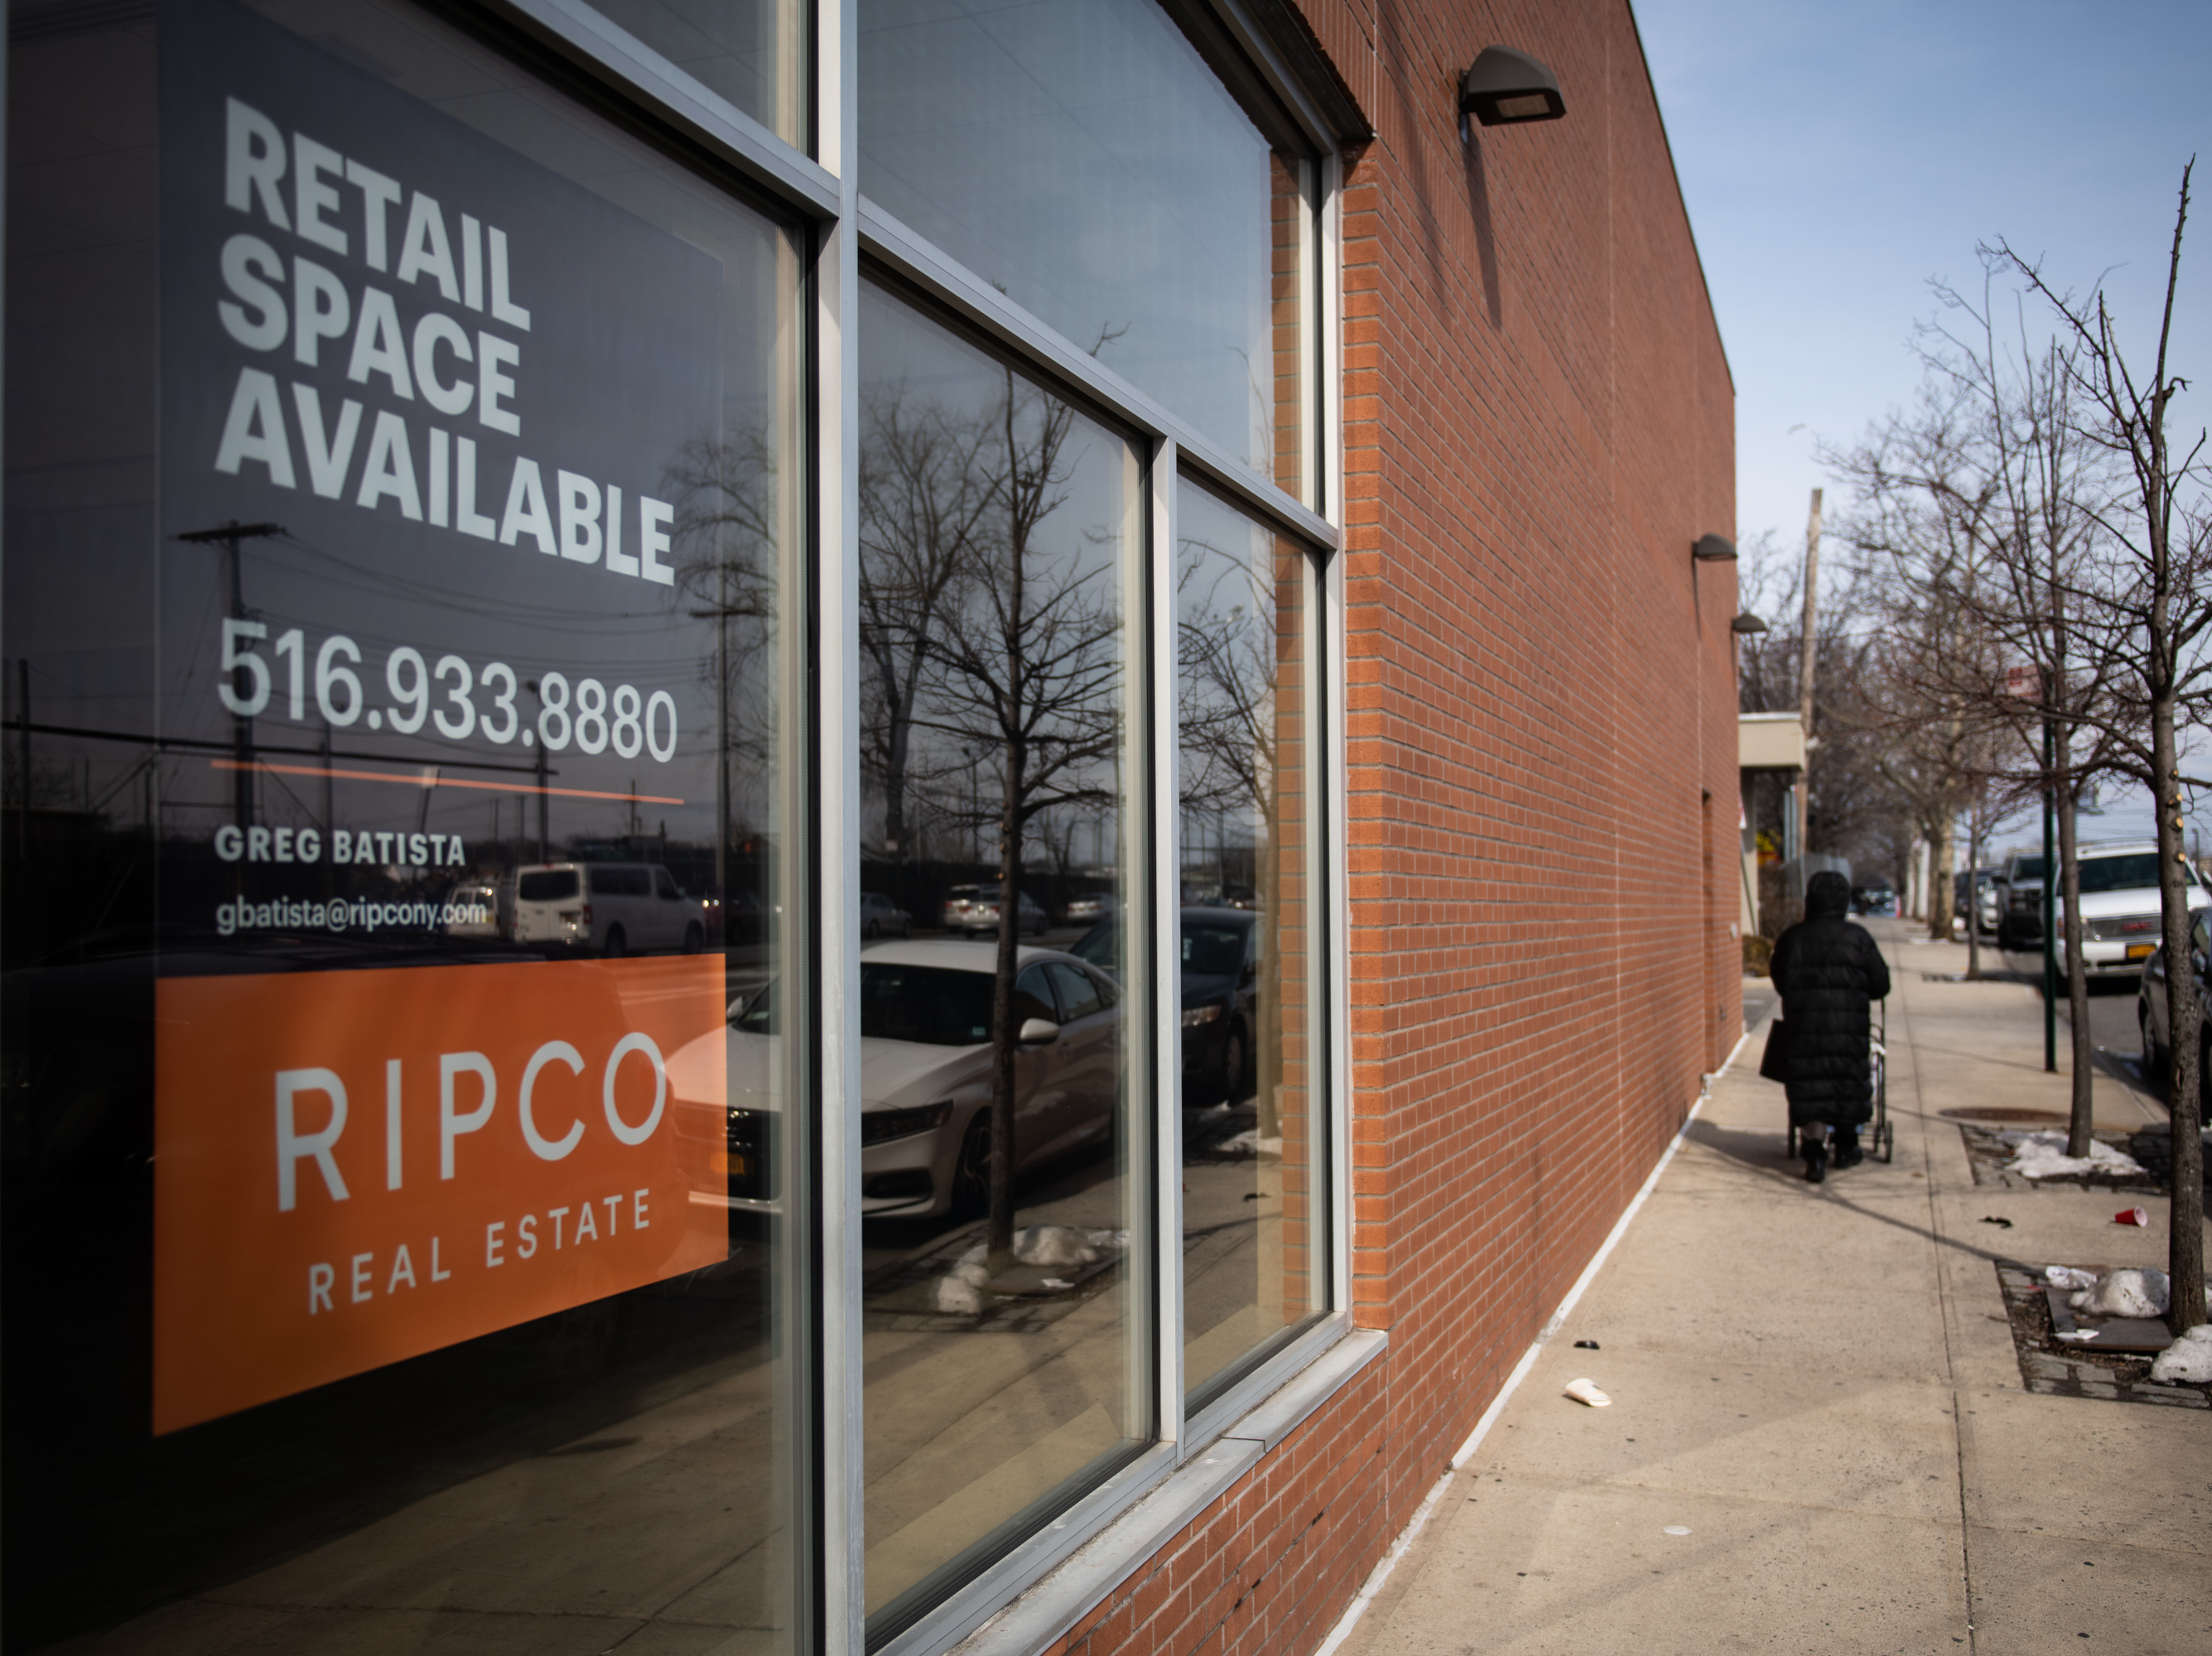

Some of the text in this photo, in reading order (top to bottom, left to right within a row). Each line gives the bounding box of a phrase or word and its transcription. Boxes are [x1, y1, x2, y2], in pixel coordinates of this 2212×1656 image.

[224, 95, 531, 332] RETAIL
[218, 233, 520, 437] SPACE
[214, 366, 675, 587] AVAILABLE
[217, 617, 677, 763] 516.933.8880
[214, 826, 466, 867] GREG BATISTA
[215, 894, 487, 936] gbatista@ripcony.com
[274, 1031, 667, 1213] RIPCO
[309, 1188, 650, 1315] REAL ESTATE
